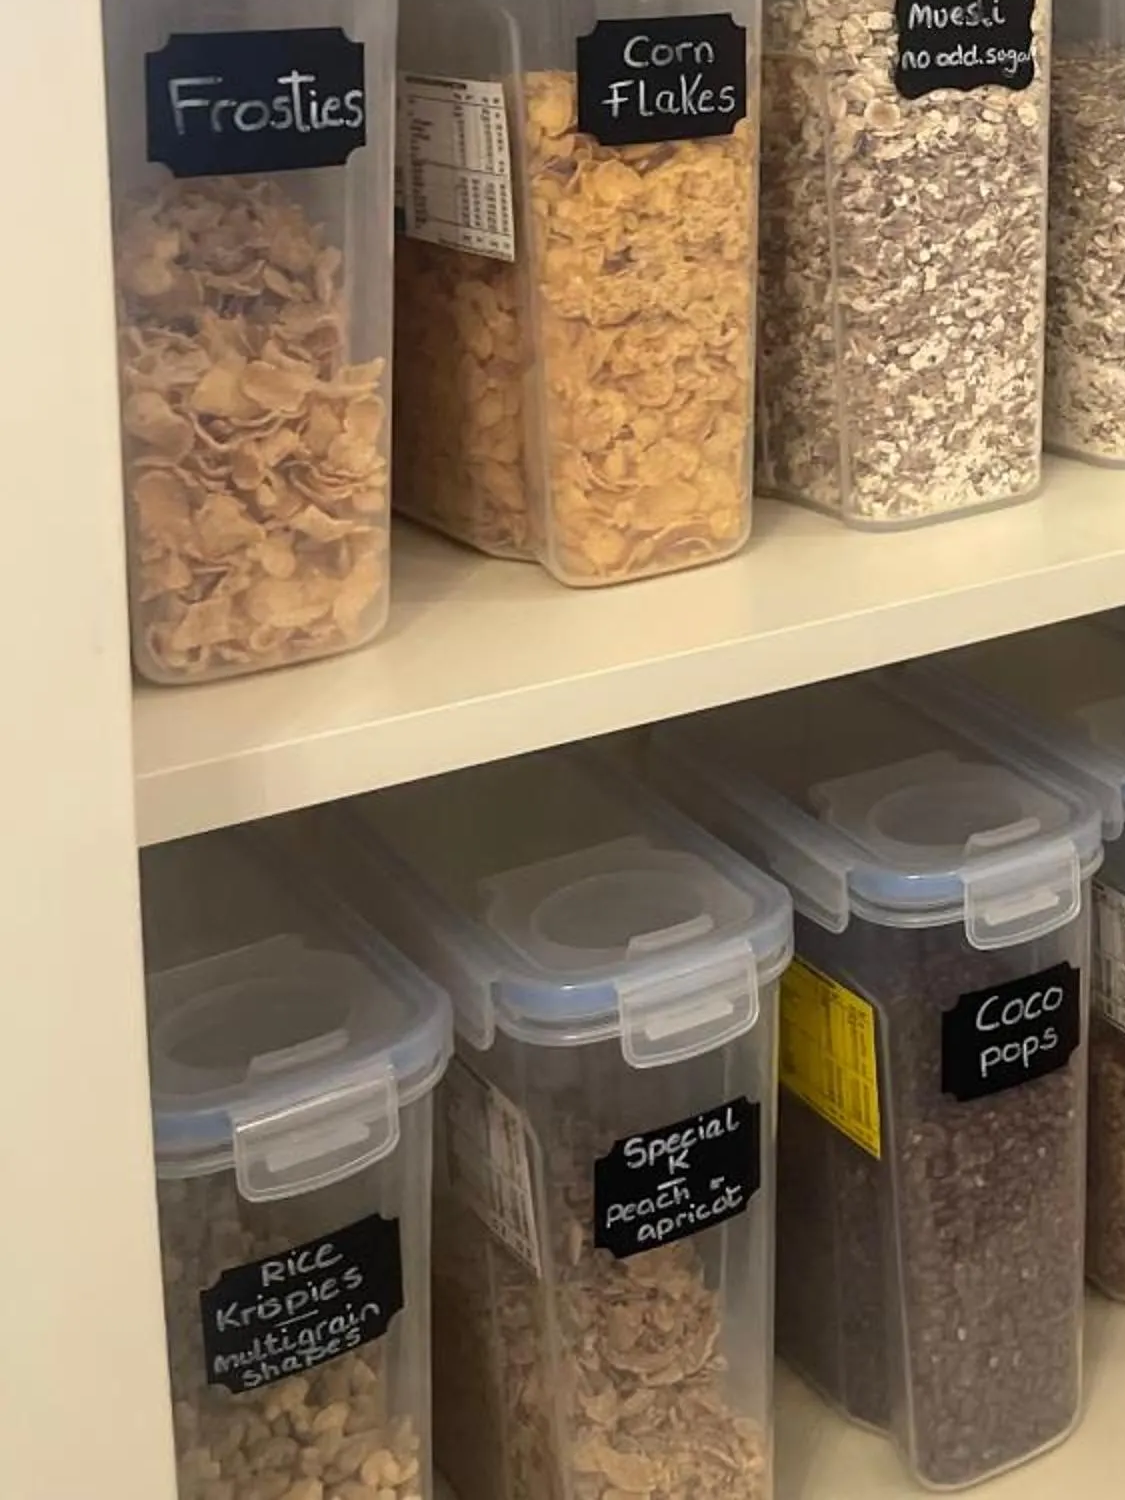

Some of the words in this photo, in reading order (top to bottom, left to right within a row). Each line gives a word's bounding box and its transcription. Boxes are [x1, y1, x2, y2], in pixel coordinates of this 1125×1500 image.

[623, 35, 716, 69] Corn
[901, 49, 932, 71] no
[168, 69, 363, 136] Frosties
[601, 73, 736, 119] Flakes
[975, 986, 1063, 1032] Coco
[623, 1107, 741, 1169] Special
[668, 1149, 691, 1175] K
[637, 1185, 744, 1242] apricot
[260, 1243, 344, 1287] Rice
[216, 1266, 364, 1333] Krispies
